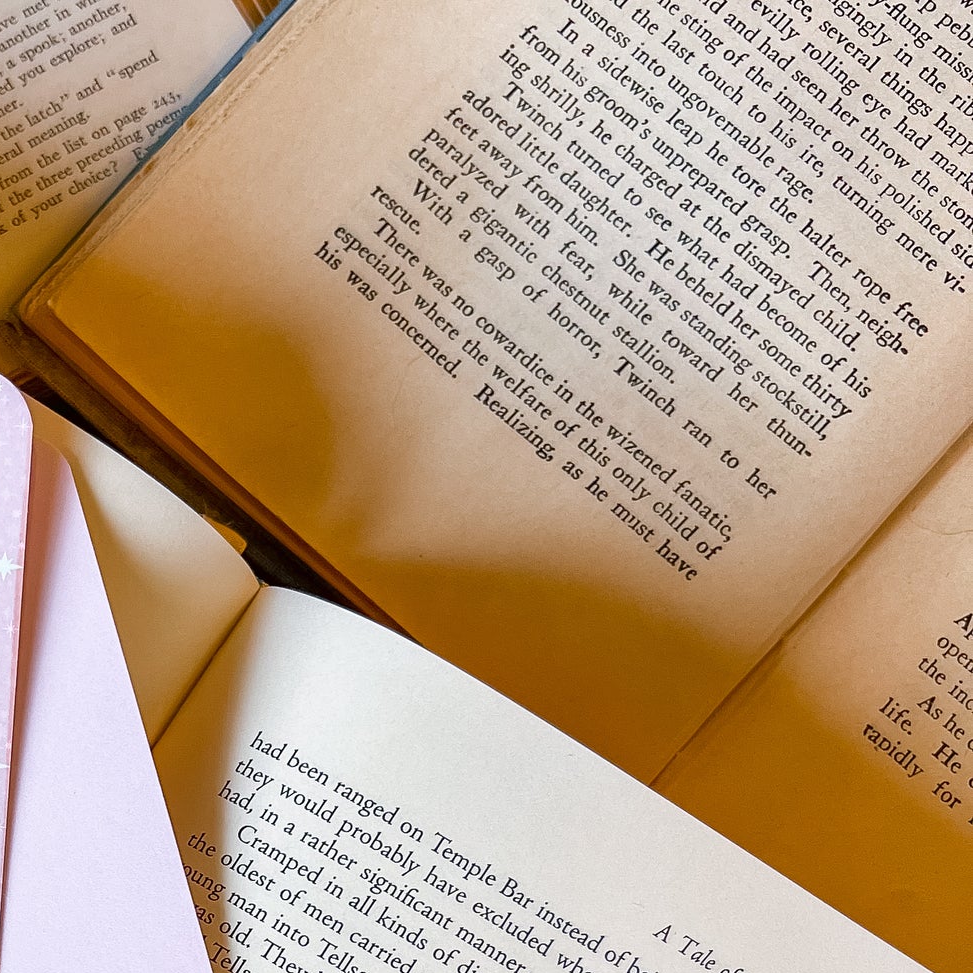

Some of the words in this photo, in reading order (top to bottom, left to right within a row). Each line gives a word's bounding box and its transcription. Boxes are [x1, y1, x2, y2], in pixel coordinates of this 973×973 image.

[27, 111, 90, 148] meaning.
[36, 152, 61, 168] the
[62, 136, 88, 154] list
[91, 126, 111, 139] on
[113, 107, 147, 132] page
[8, 189, 33, 206] the
[35, 167, 73, 191] three
[76, 130, 143, 173] preceding
[12, 210, 27, 226] of
[30, 193, 63, 220] your
[68, 161, 118, 195] choice?
[408, 147, 458, 190] dered
[456, 191, 469, 204] a
[469, 207, 538, 264] gigantic
[541, 265, 610, 326] chestnut
[612, 326, 675, 384] stallion.
[413, 178, 453, 226] With
[458, 229, 472, 243] a
[474, 246, 516, 282] gasp
[522, 285, 549, 303] of
[547, 302, 602, 359] horror,
[613, 356, 676, 417] Twinch
[681, 419, 712, 448] ran
[720, 450, 740, 469] to
[745, 467, 777, 500] her
[373, 217, 420, 267] There
[422, 265, 453, 297] was
[451, 295, 474, 317] no
[475, 316, 554, 386] cowardice
[553, 379, 574, 404] in
[575, 400, 604, 428] the
[607, 425, 677, 484] wizened
[672, 480, 731, 543] fanatic,
[918, 658, 946, 685] the
[879, 697, 912, 735] life.
[931, 741, 961, 774] He
[916, 696, 943, 720] As
[942, 713, 965, 740] he
[863, 724, 924, 778] rapidly
[931, 781, 962, 809] for
[652, 925, 672, 944] A
[678, 935, 716, 970] Tale
